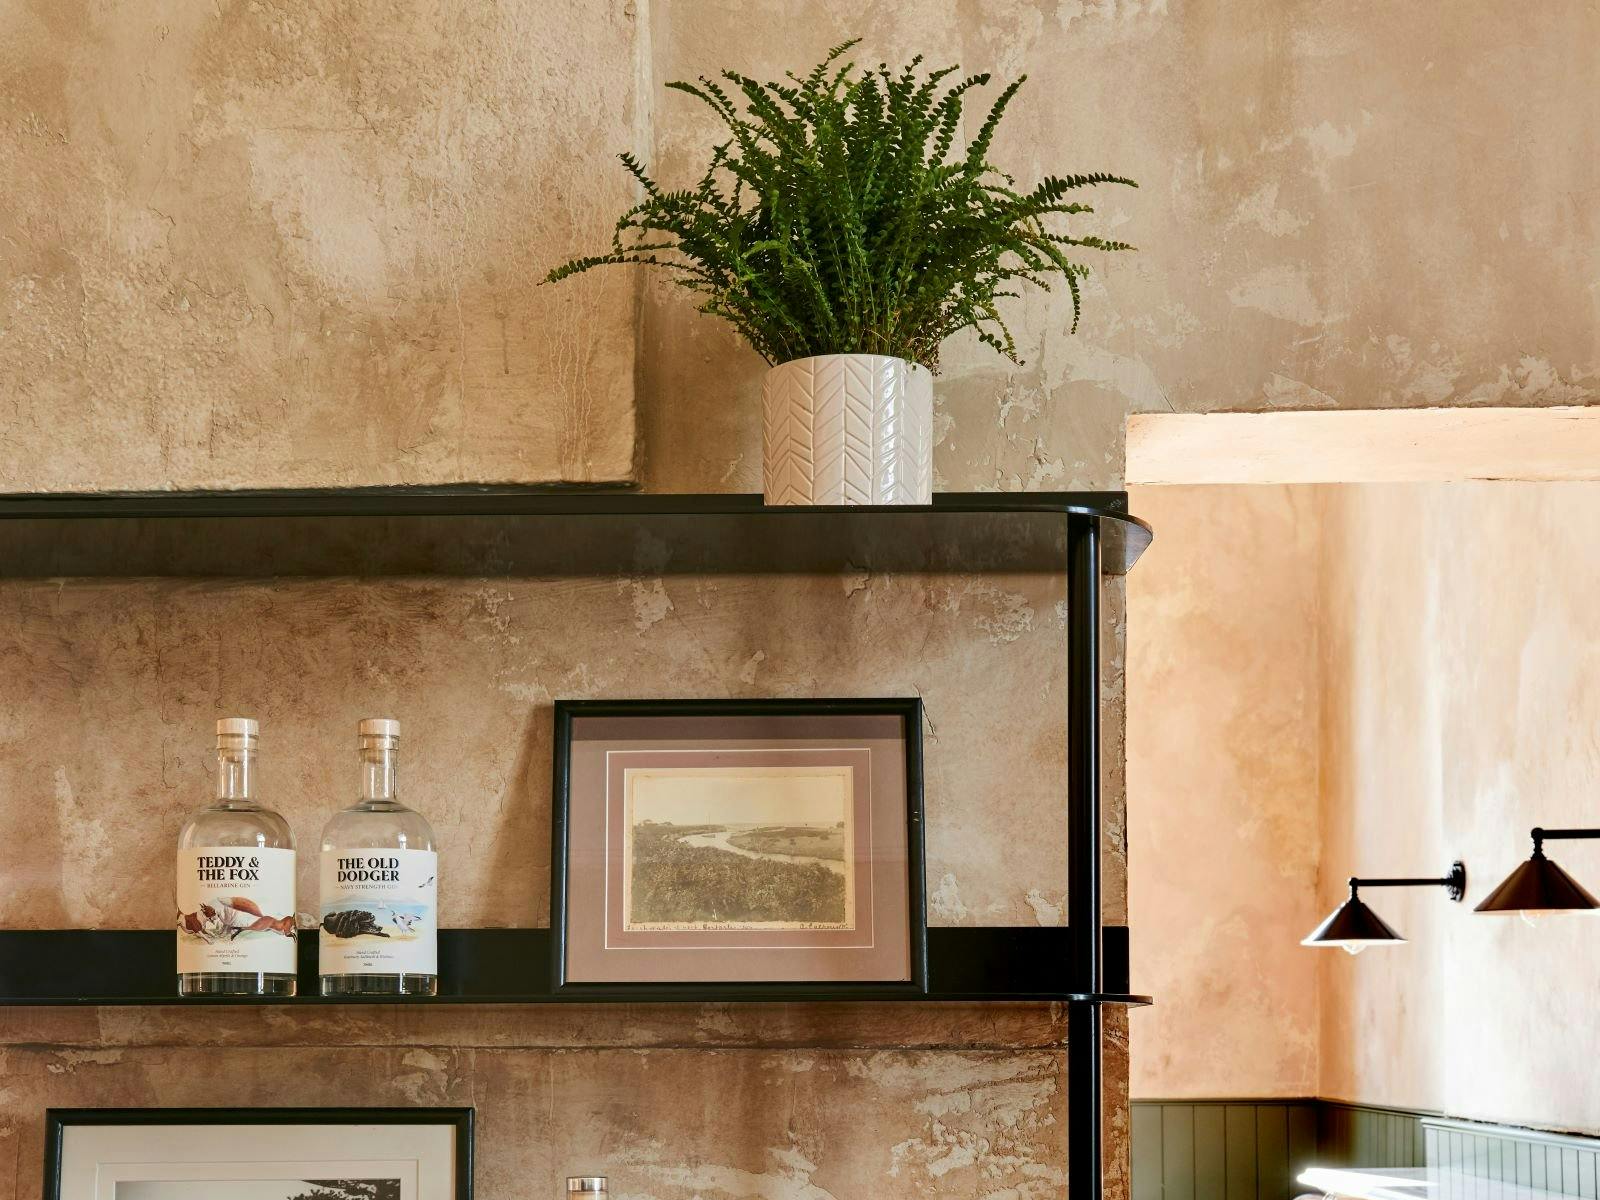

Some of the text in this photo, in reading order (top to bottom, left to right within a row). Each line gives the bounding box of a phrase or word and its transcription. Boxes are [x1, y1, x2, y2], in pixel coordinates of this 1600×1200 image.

[197, 856, 260, 868] TEDDY &
[337, 857, 399, 870] THE OLD
[197, 868, 259, 881] THE FOX
[337, 870, 400, 882] DODGER
